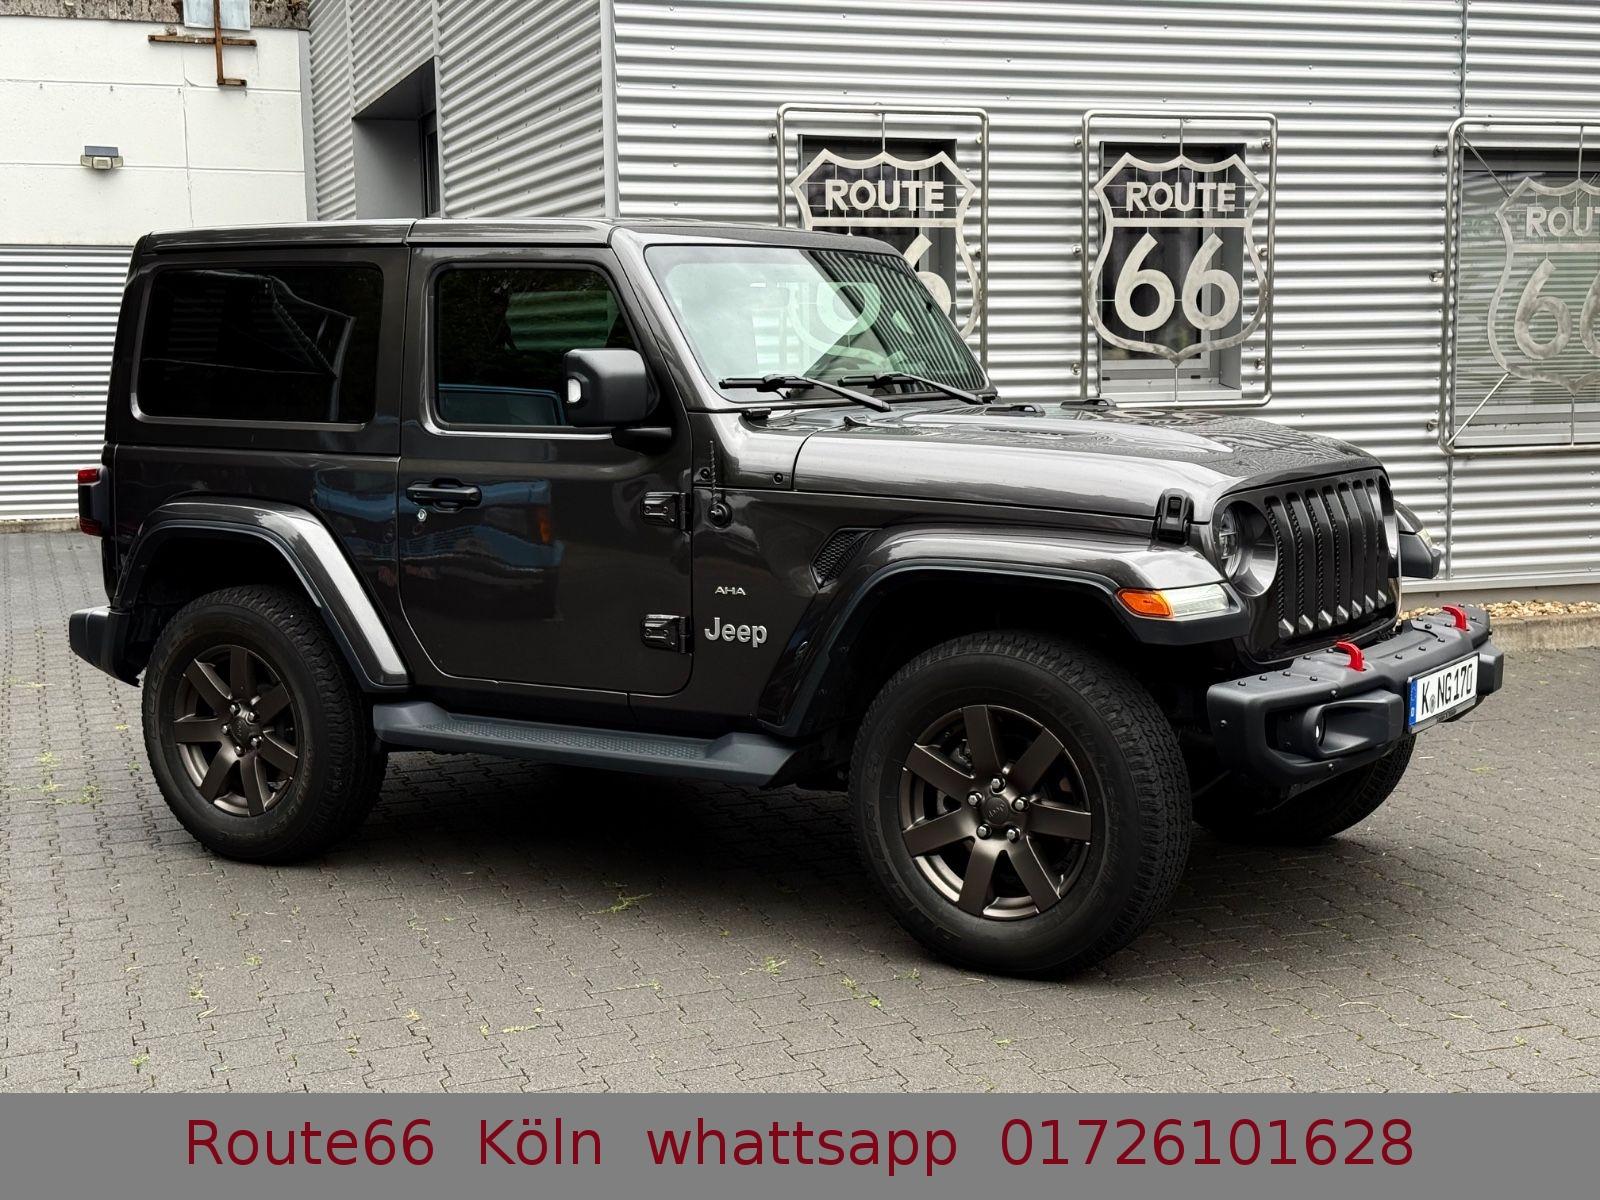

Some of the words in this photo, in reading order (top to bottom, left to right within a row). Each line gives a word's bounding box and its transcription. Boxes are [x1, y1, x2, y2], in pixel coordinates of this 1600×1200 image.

[825, 179, 944, 212] ROUTE
[1126, 182, 1236, 212] ROUTE
[1526, 206, 1600, 238] ROU
[1114, 233, 1240, 332] 66
[714, 586, 747, 596] AHA
[704, 617, 768, 648] Jeep
